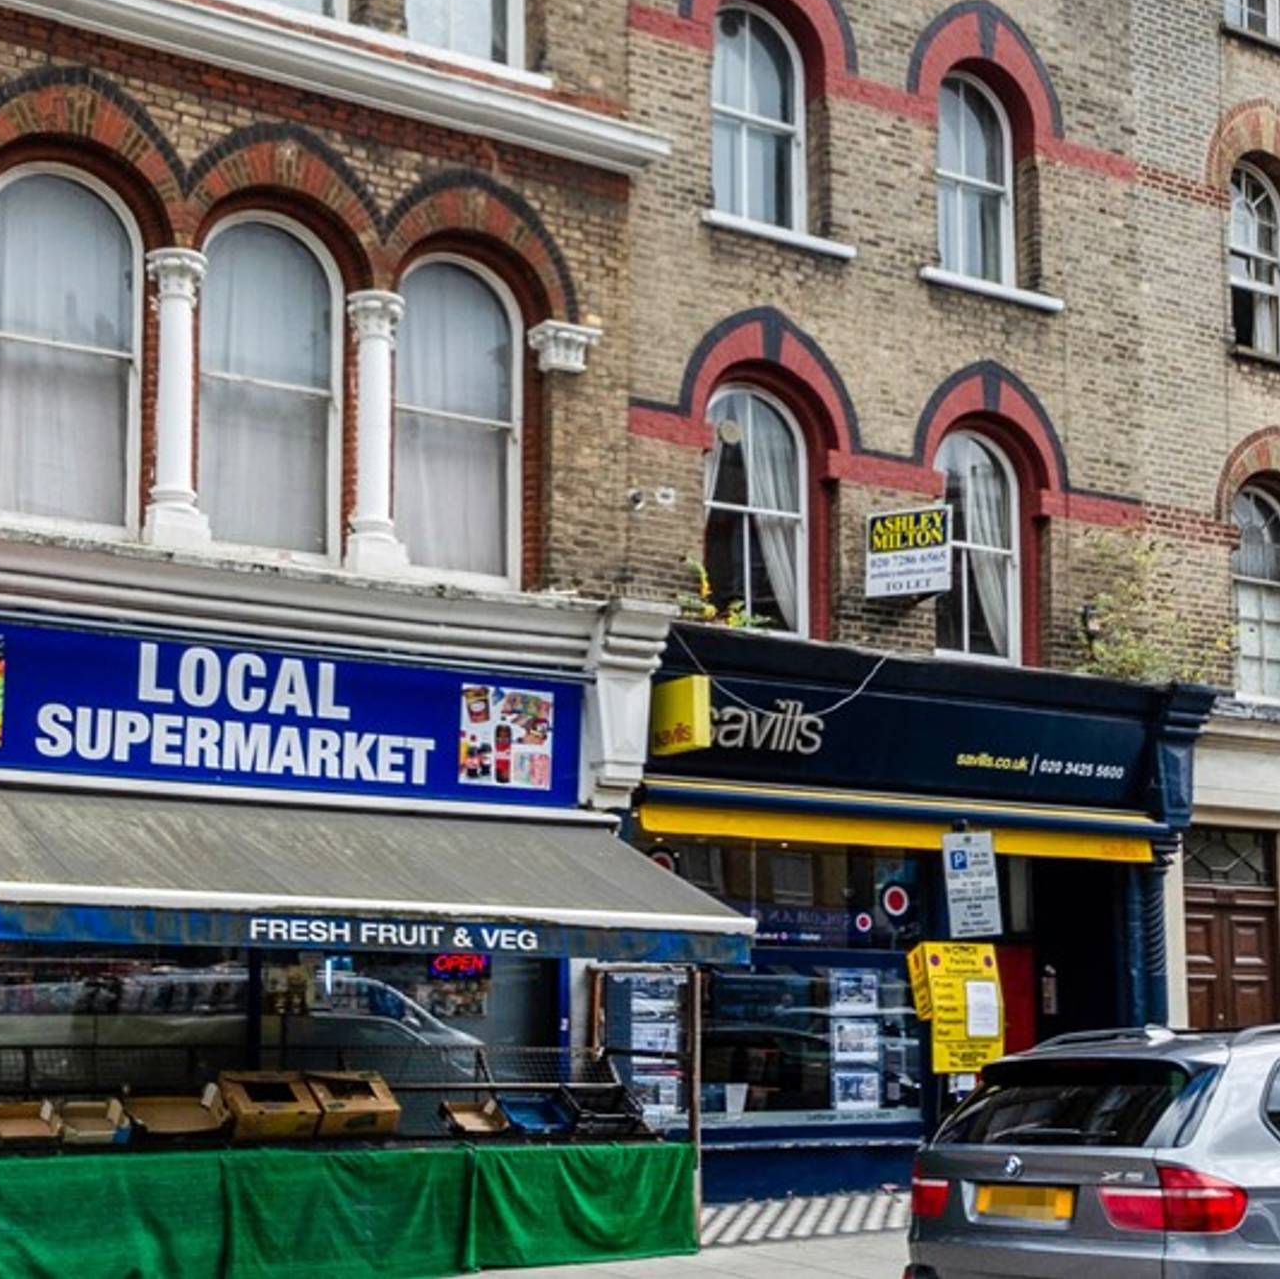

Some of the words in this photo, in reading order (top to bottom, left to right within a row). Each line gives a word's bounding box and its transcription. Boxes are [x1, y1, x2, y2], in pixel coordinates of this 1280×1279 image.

[873, 511, 945, 534] ASHLEY
[872, 527, 945, 550] MILTON
[137, 642, 351, 720] LOCAL
[34, 703, 435, 785] SUPERMARKET
[250, 919, 351, 943] FRESH
[360, 923, 444, 946] FRUIT
[453, 927, 472, 948] &
[481, 928, 539, 950] VEG
[433, 954, 485, 972] OPEN
